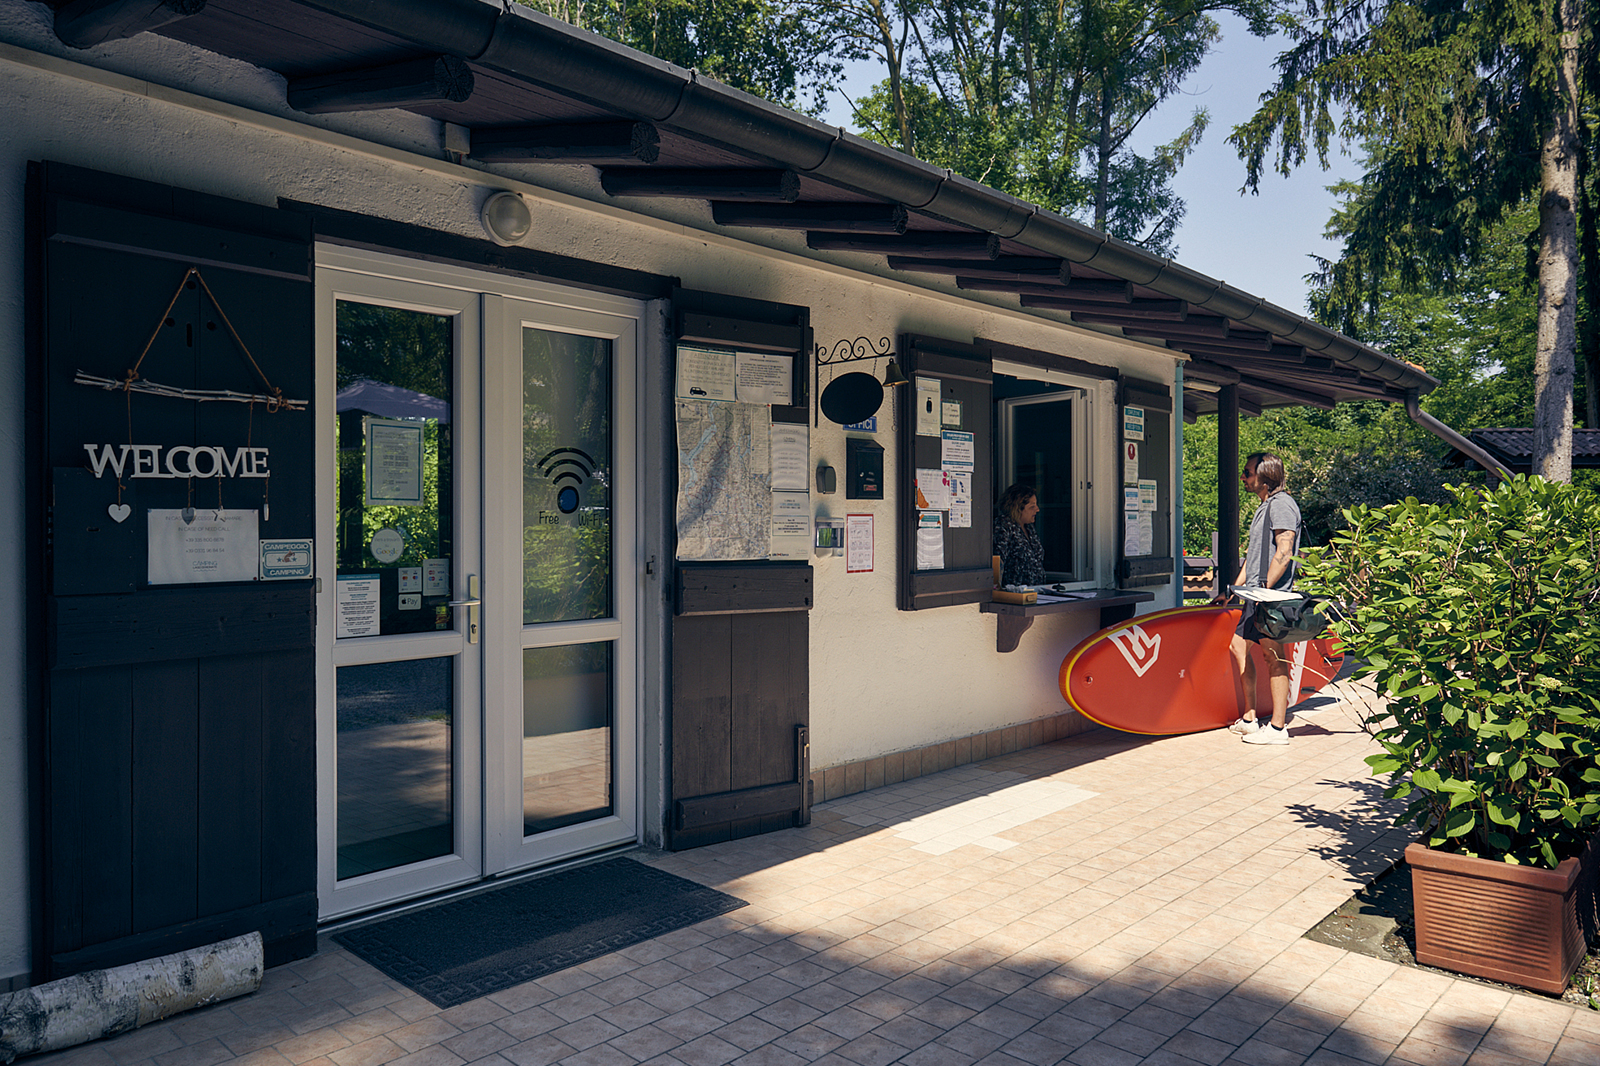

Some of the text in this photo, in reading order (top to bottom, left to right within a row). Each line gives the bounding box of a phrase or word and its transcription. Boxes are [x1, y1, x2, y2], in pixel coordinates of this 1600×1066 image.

[83, 443, 270, 478] WELCOME
[539, 510, 601, 526] Free Wi-Fi
[264, 543, 309, 551] CAMPEGGIO
[375, 547, 399, 557] Google
[269, 568, 305, 577] CAMPING
[407, 597, 418, 606] Pay
